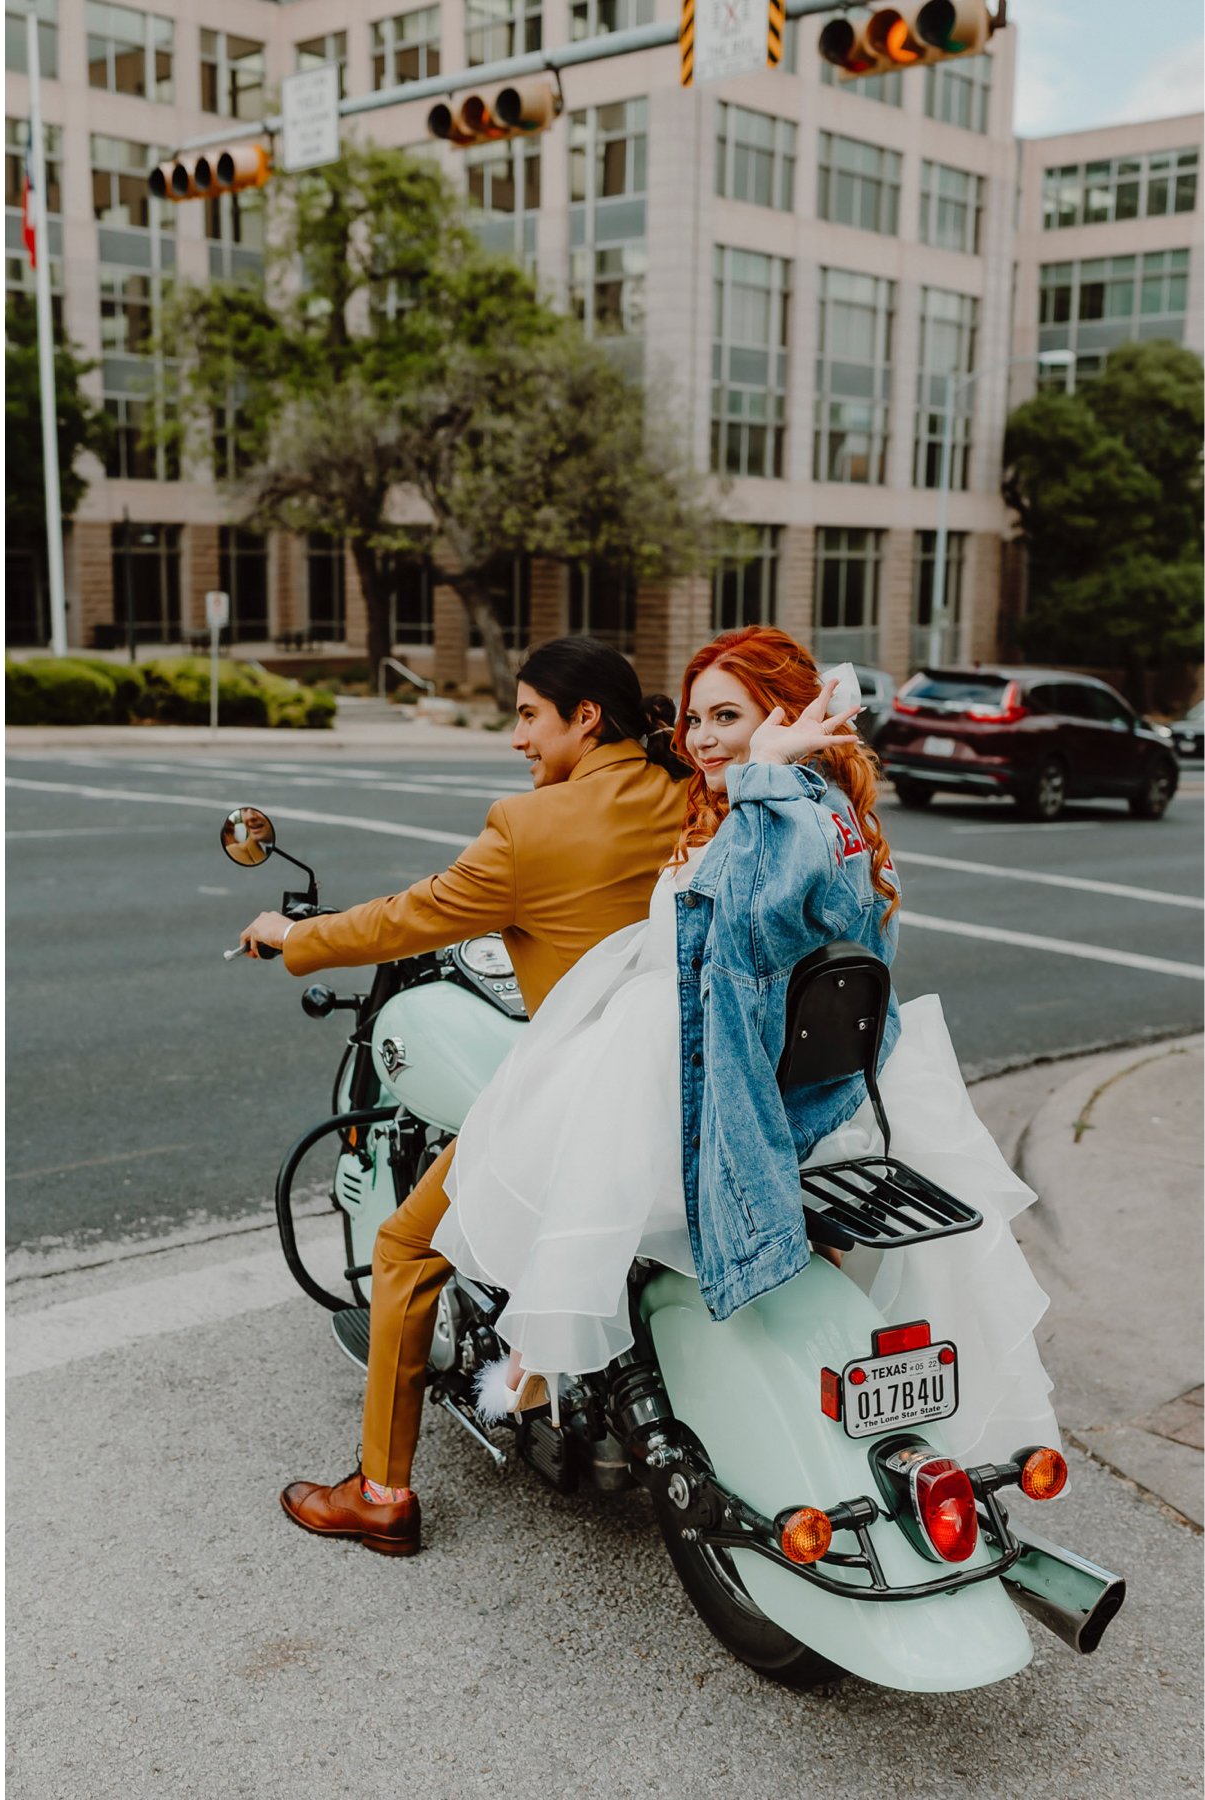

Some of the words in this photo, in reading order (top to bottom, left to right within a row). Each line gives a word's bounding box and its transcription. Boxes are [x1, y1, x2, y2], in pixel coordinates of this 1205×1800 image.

[871, 1363, 908, 1380] TEXAS
[915, 1362, 924, 1371] 05
[928, 1360, 938, 1368] 22
[858, 1374, 944, 1420] 017B4U
[864, 1419, 879, 1428] The
[880, 1414, 899, 1425] Lone
[901, 1410, 918, 1419] Star
[920, 1404, 941, 1415] State
